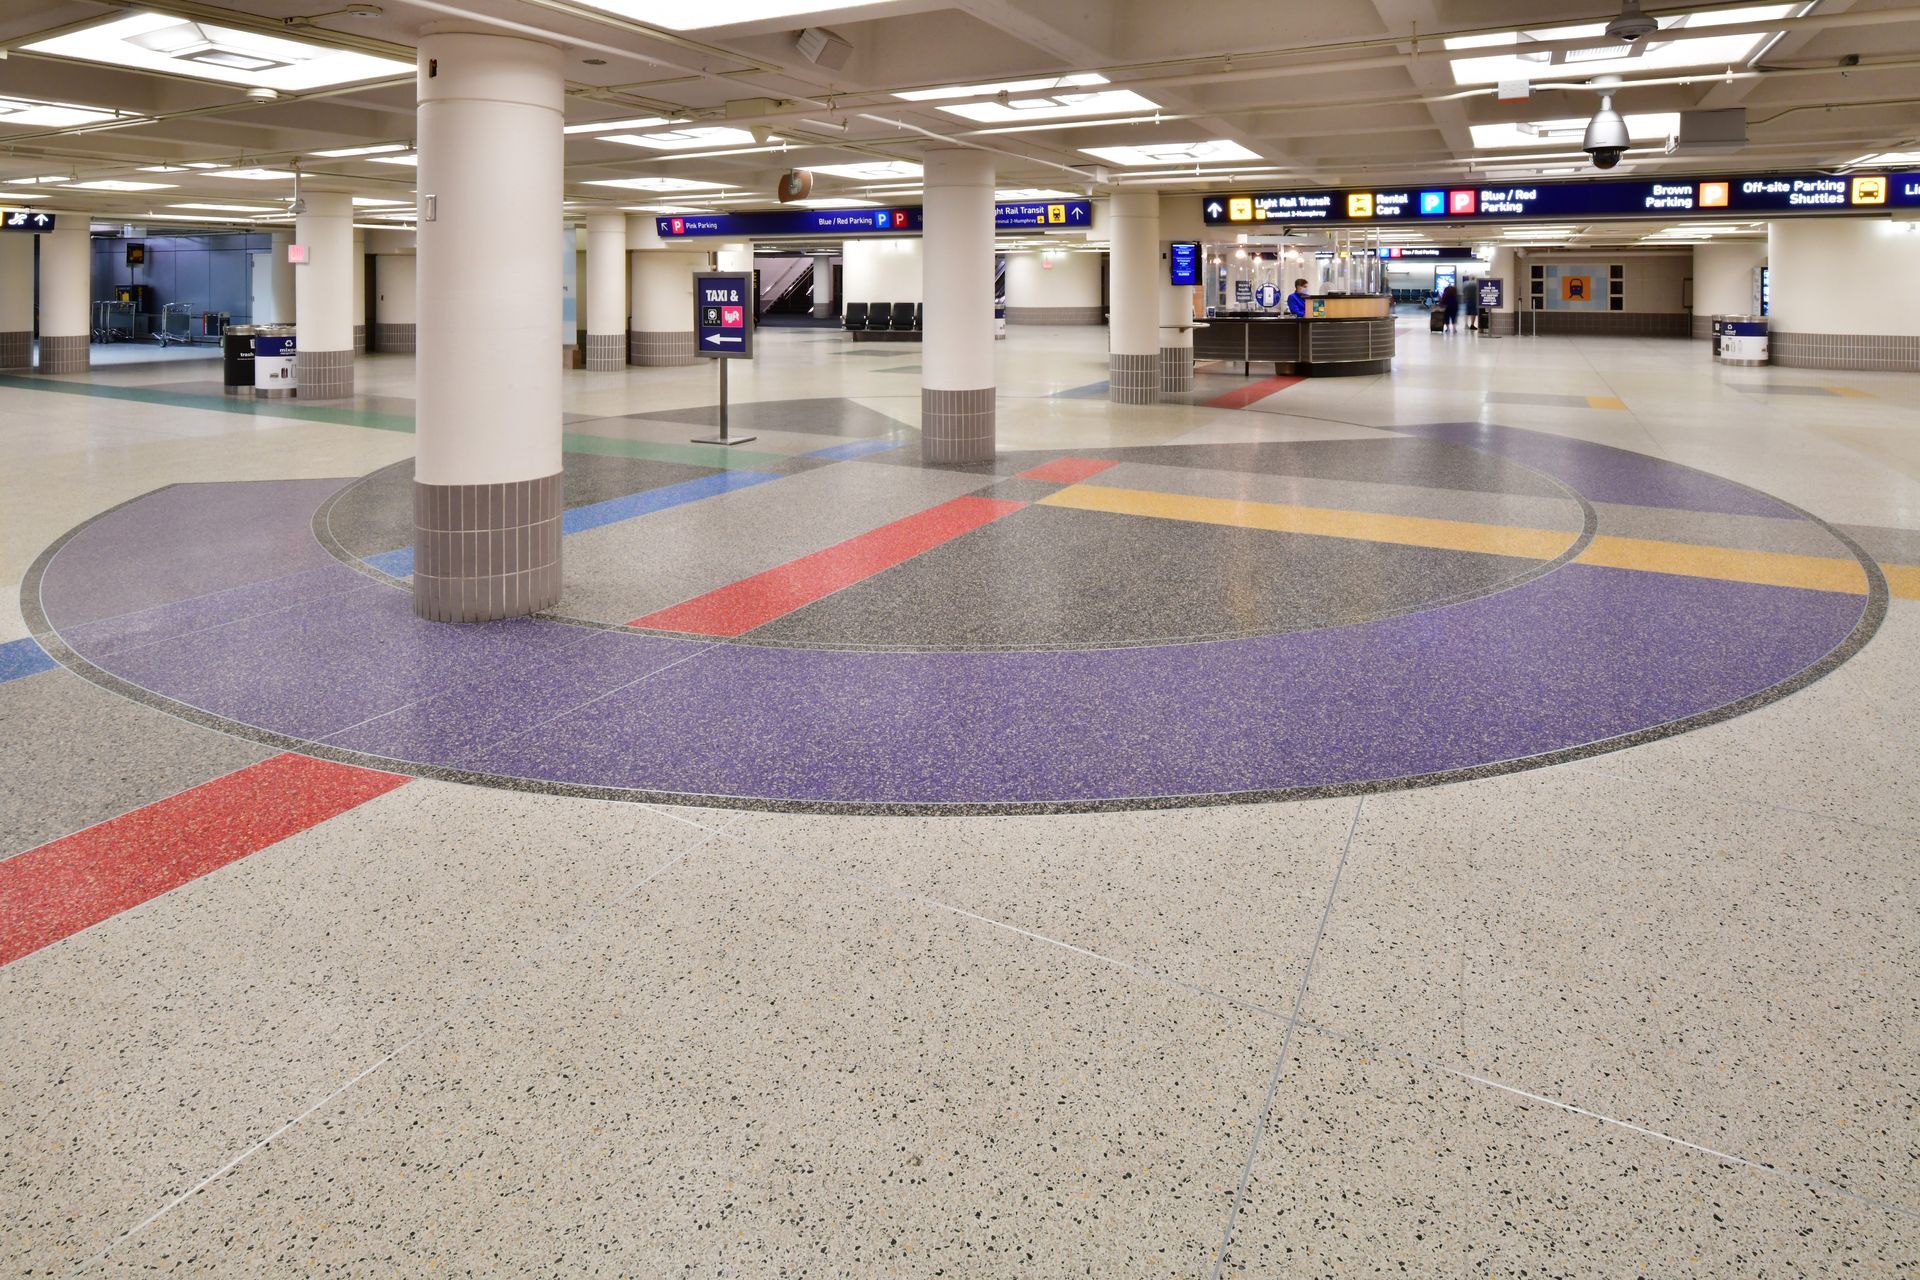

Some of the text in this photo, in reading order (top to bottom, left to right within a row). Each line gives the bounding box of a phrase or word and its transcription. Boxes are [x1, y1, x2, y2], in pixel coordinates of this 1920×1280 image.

[1653, 185, 1692, 195] Brown
[1743, 180, 1845, 193] Off-site Parking
[1376, 193, 1408, 204] Rental
[1481, 189, 1536, 201] Blue / Red
[1705, 186, 1722, 204] P
[1789, 193, 1845, 205] Shuttles
[1255, 196, 1331, 209] Light Rail Transit
[1425, 195, 1440, 211] P
[1455, 194, 1469, 210] P
[1481, 201, 1523, 213] Parking
[1645, 197, 1693, 209] Parking
[1005, 207, 1018, 215] Rail
[1020, 206, 1044, 214] Transit
[1376, 205, 1400, 215] Cars
[837, 217, 848, 225] Red
[849, 217, 872, 225] Parking
[878, 213, 887, 225] P
[896, 213, 904, 225] P
[674, 221, 682, 231] P
[697, 222, 718, 230] Parking
[705, 289, 739, 302] TAXI &
[724, 310, 740, 323] lyft
